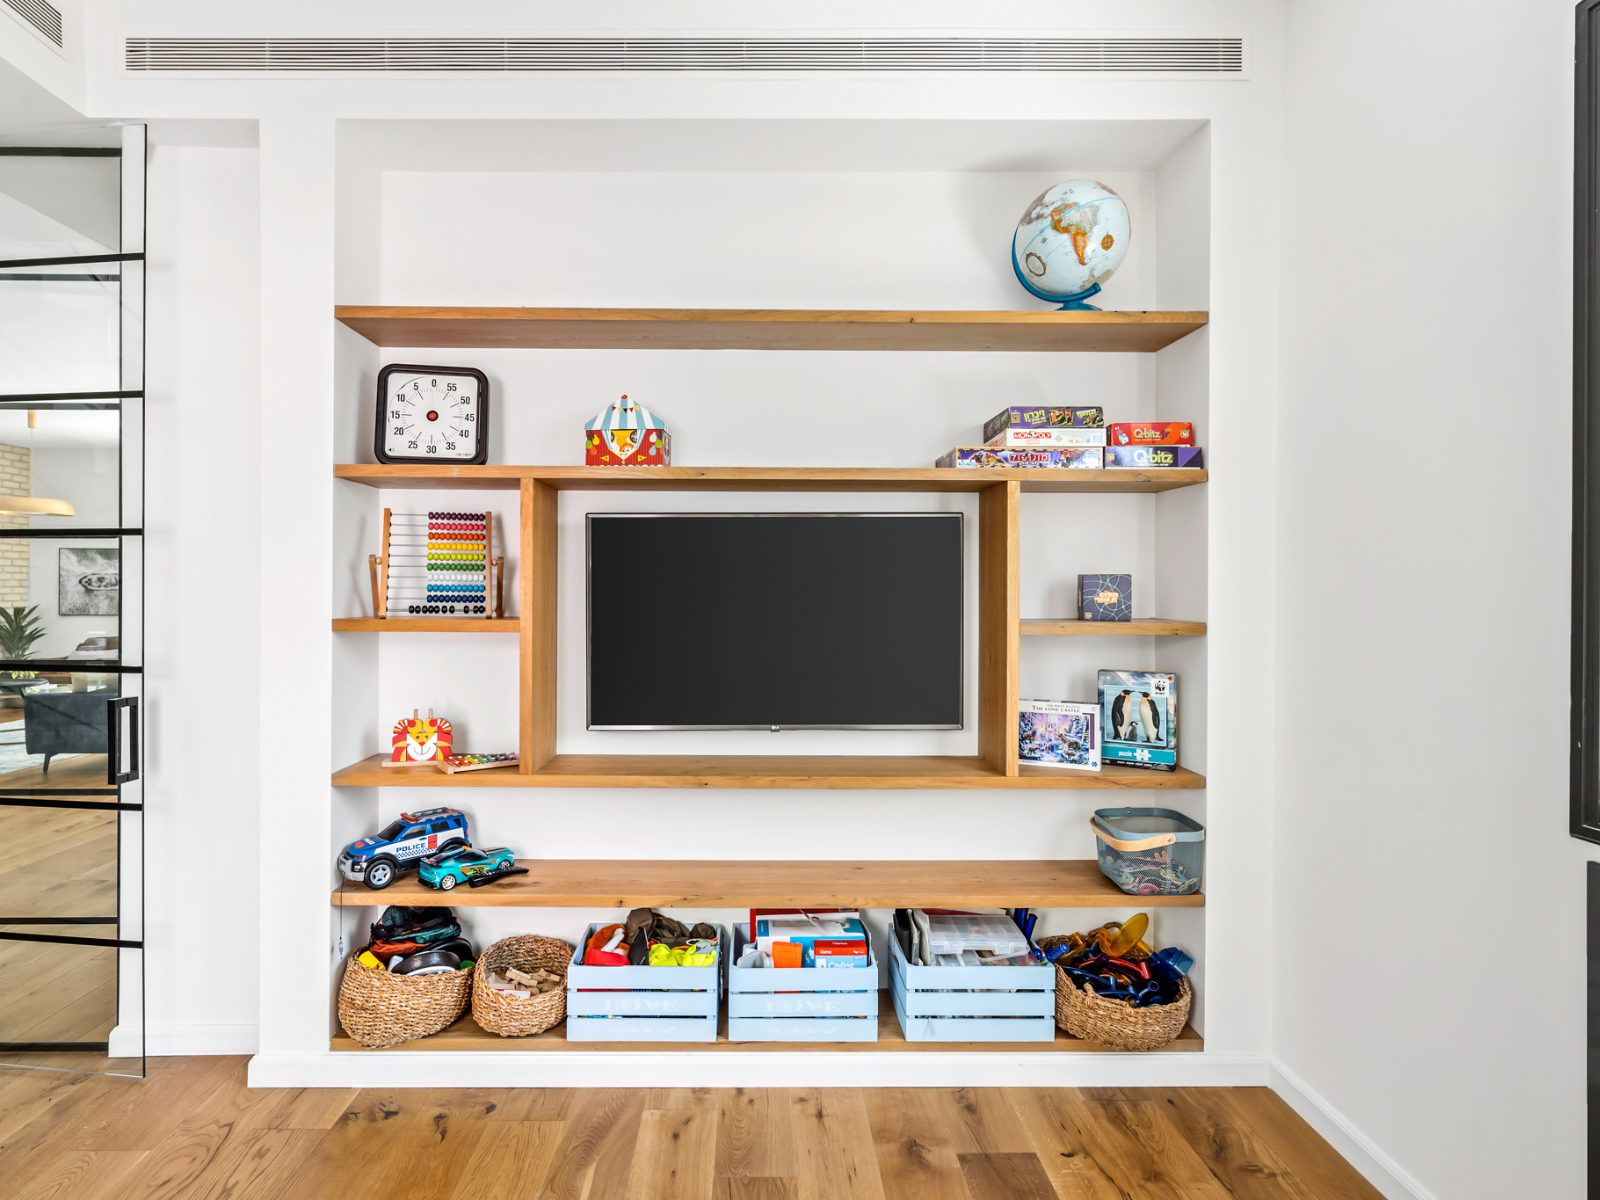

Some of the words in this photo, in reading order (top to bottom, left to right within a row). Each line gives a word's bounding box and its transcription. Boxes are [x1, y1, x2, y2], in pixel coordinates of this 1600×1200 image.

[413, 382, 419, 390] 5
[431, 379, 436, 388] 0
[447, 383, 457, 392] 55
[396, 394, 406, 402] 10
[460, 396, 470, 404] 50
[390, 411, 400, 419] 15
[464, 414, 474, 422] 45
[394, 427, 404, 436] 20
[459, 430, 470, 438] 40
[408, 440, 418, 449] 25
[446, 442, 456, 450] 35
[426, 446, 436, 454] 30
[396, 842, 426, 853] POLICE
[604, 998, 679, 1012] LOVE
[766, 999, 840, 1012] LOVE
